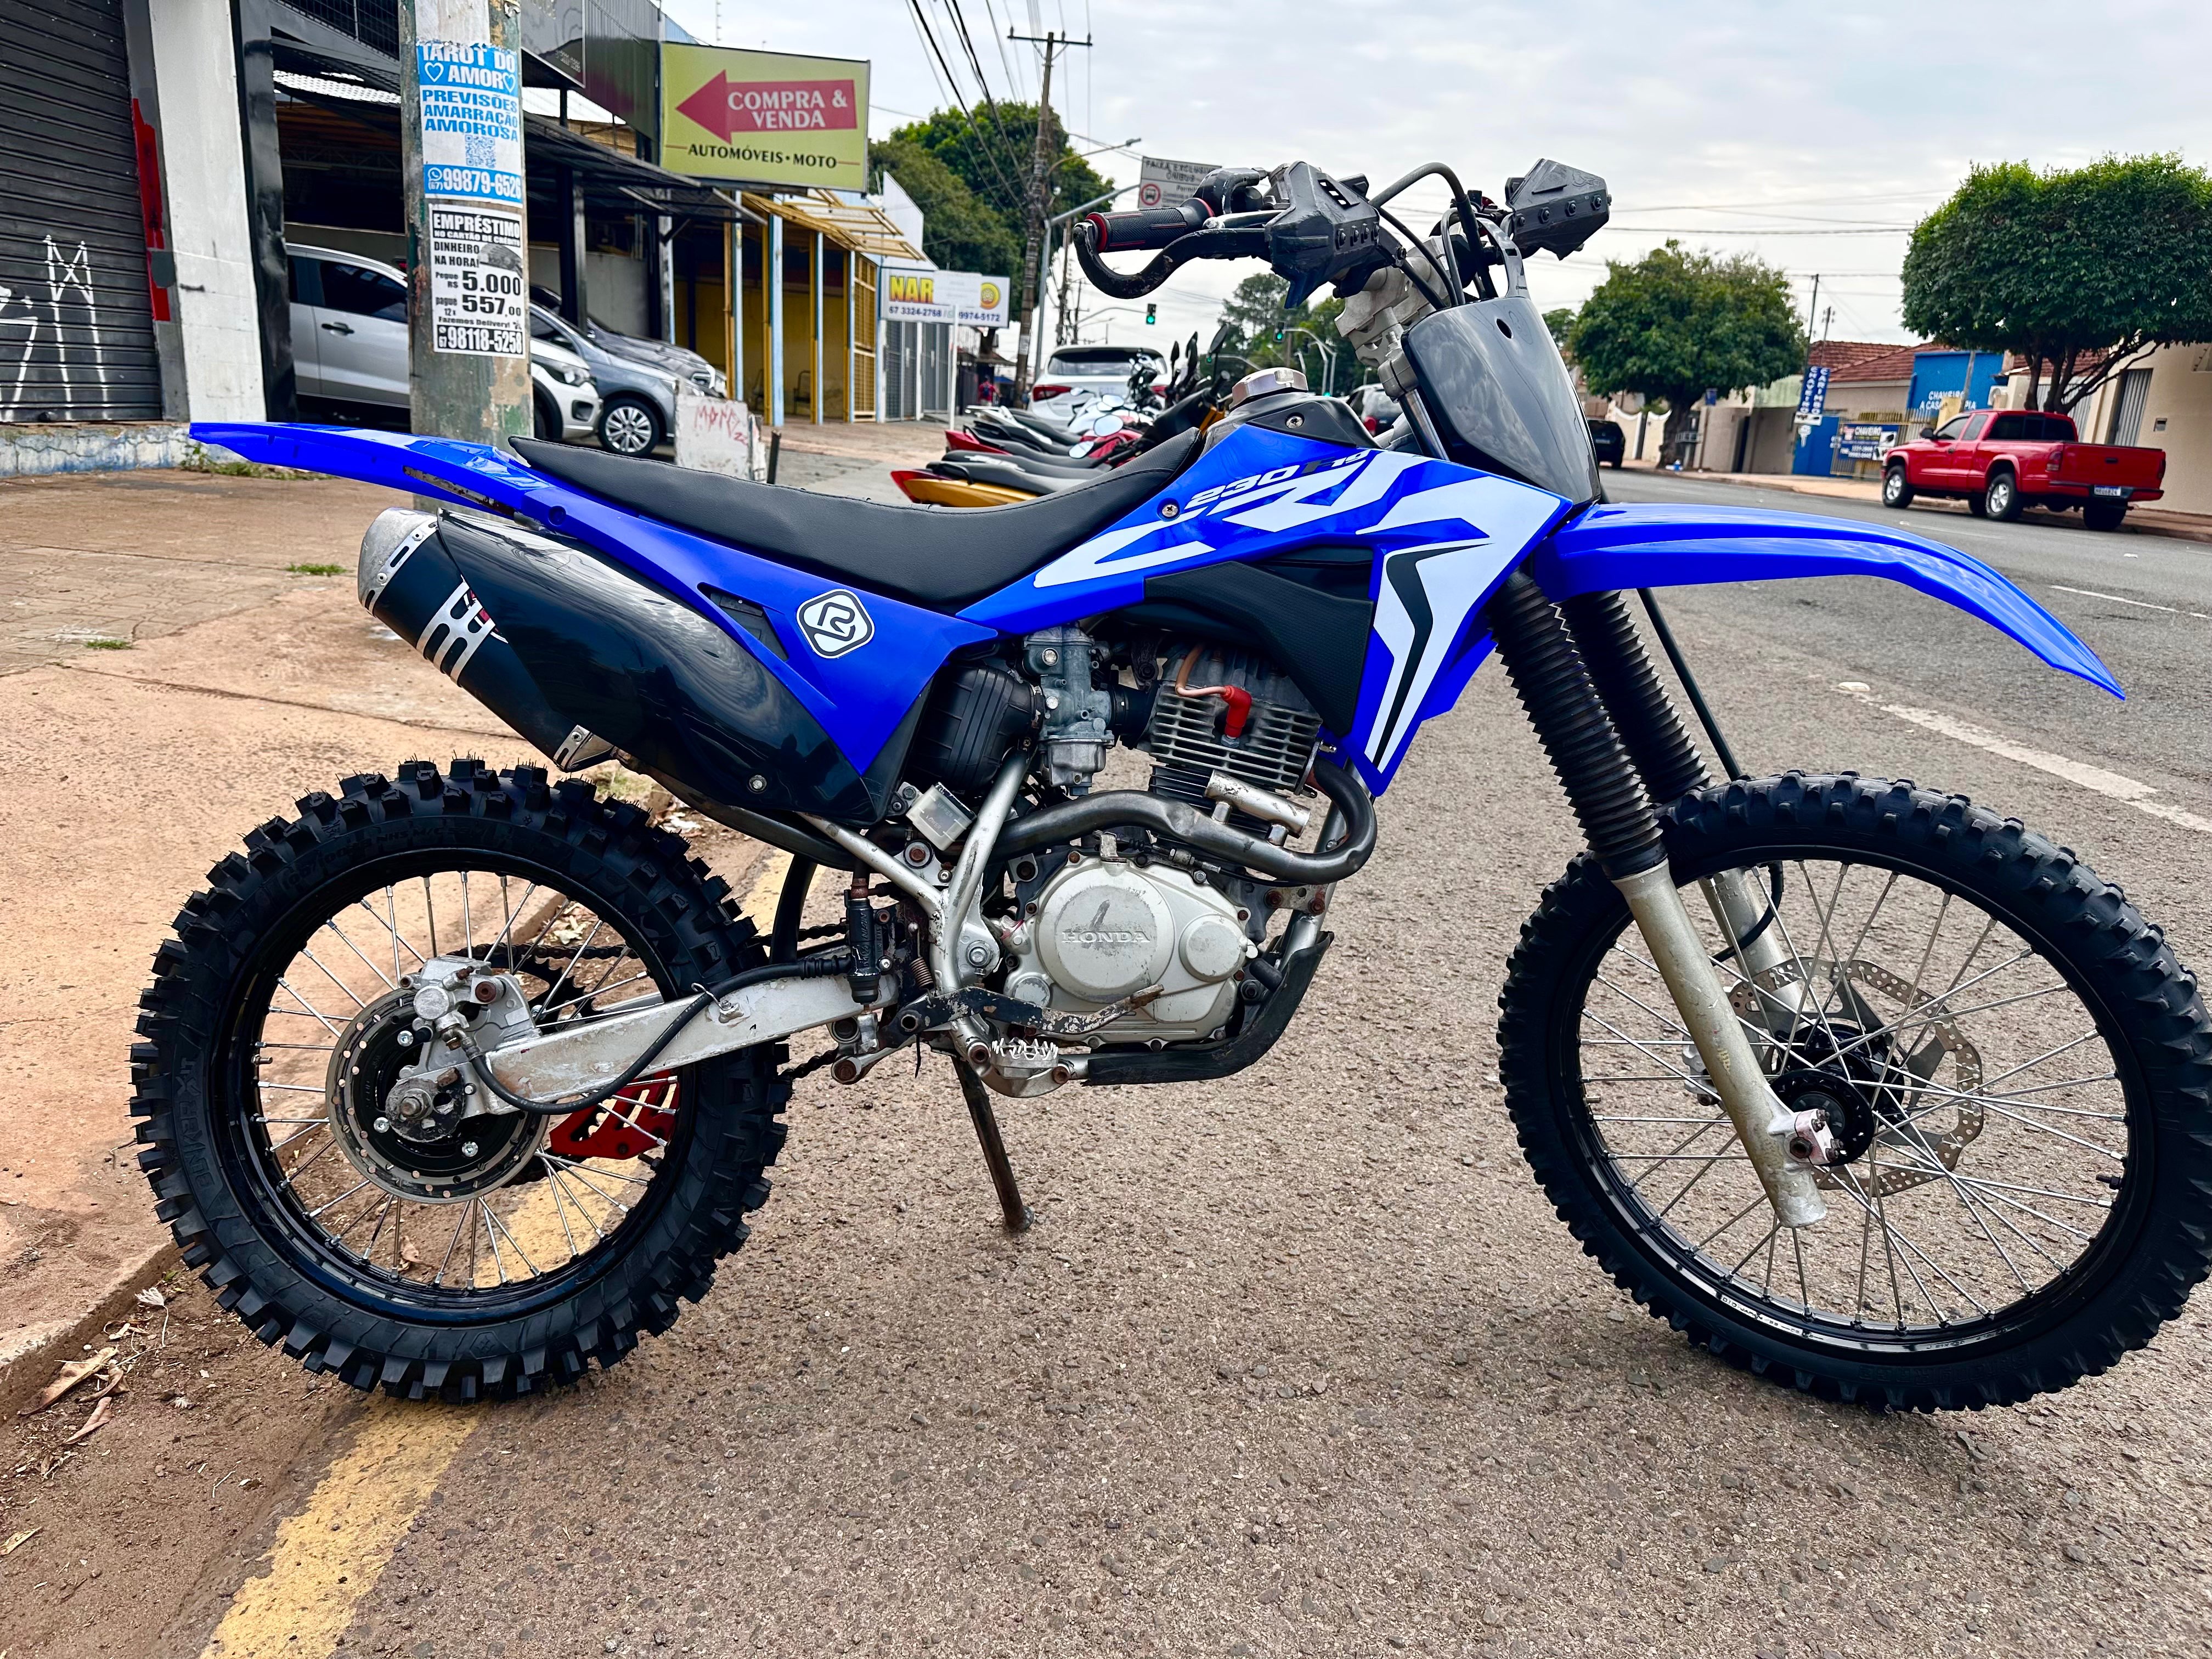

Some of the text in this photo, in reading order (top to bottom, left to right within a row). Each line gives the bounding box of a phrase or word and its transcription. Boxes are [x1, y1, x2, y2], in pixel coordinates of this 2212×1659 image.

[422, 43, 515, 73] TAROT DO
[448, 65, 504, 90] AMOR
[422, 89, 517, 113] PREVISÕES
[727, 89, 848, 110] COMPRA &
[424, 105, 518, 128] AMARRAÇÃO
[751, 110, 826, 129] VENDA
[425, 119, 518, 143] AMOROSA
[688, 143, 838, 168] AUTOMÓVEIS MOTO
[443, 168, 521, 198] 99879-6526
[433, 213, 520, 238] EMPRÉSTIMO
[447, 231, 481, 241] CARTÃO
[434, 241, 479, 254] DINHEIRO
[435, 255, 479, 268] NA HORA!
[462, 270, 521, 296] 5.000
[462, 294, 521, 318] 557,00
[438, 316, 474, 325] Fazemos
[448, 326, 522, 354] 98118-5258
[1061, 930, 1150, 944] HONDA
